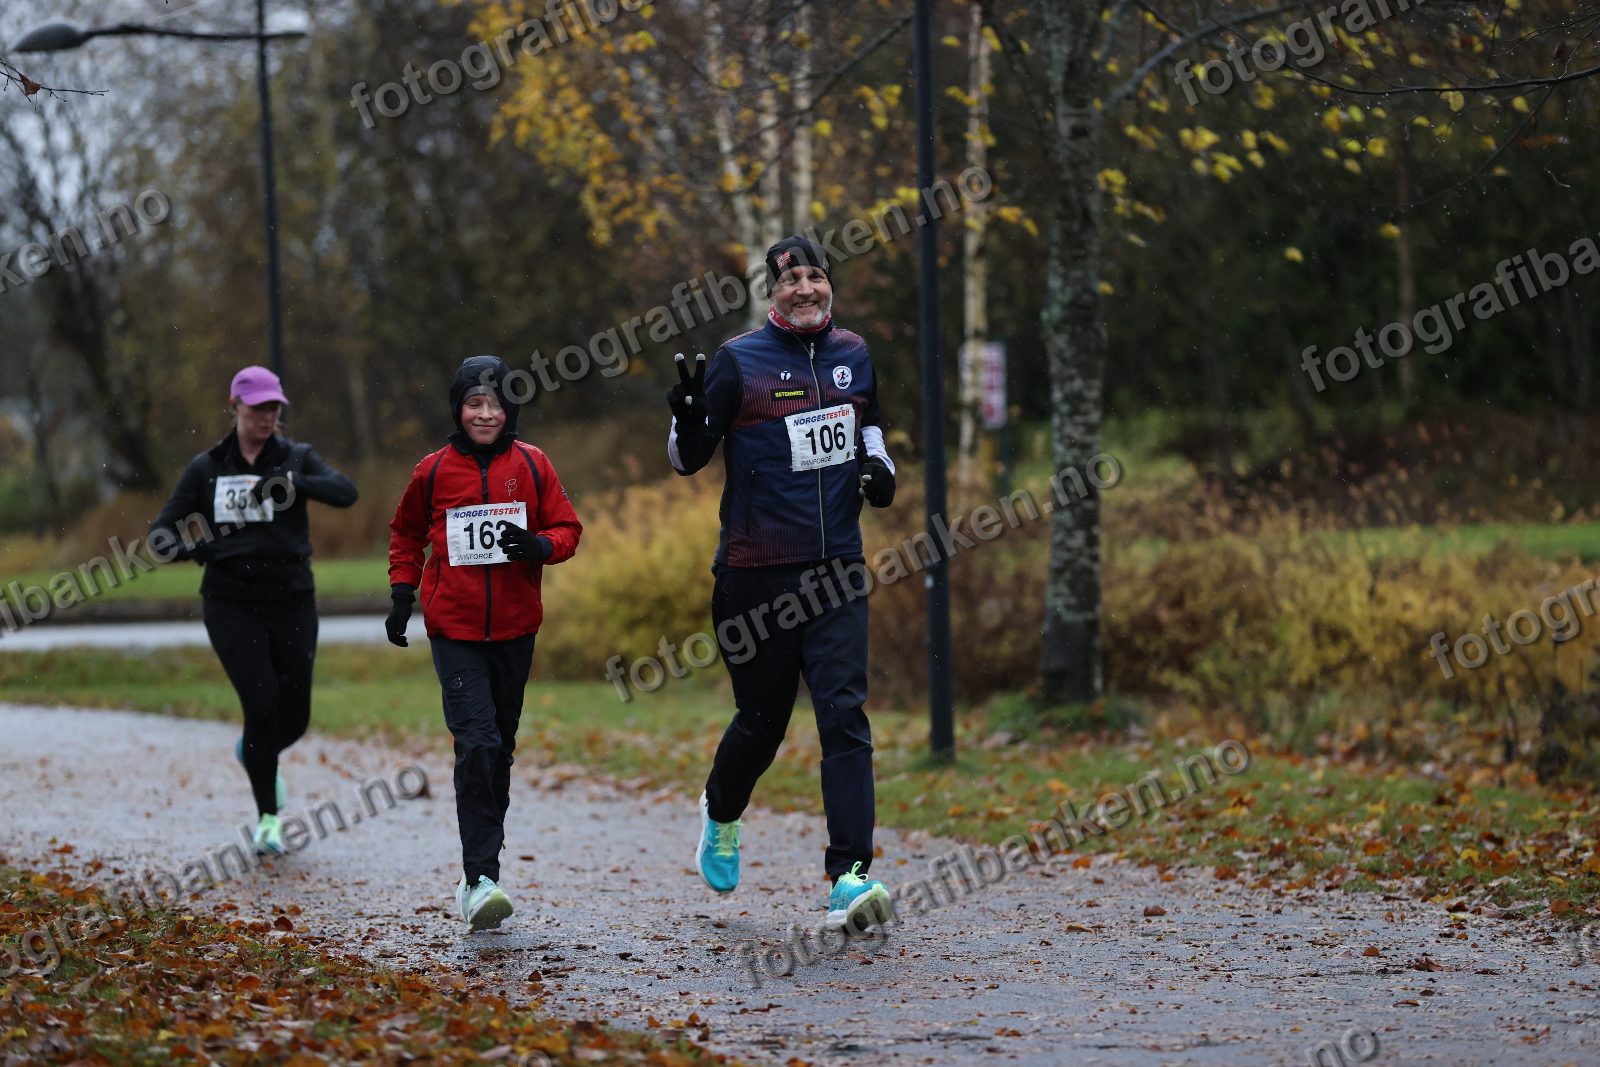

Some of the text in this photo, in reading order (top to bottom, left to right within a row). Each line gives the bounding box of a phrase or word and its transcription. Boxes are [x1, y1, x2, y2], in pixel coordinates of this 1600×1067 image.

[793, 408, 850, 427] NORGESTESTEN
[805, 422, 846, 455] 106
[453, 507, 521, 519] NORGESTESTEN
